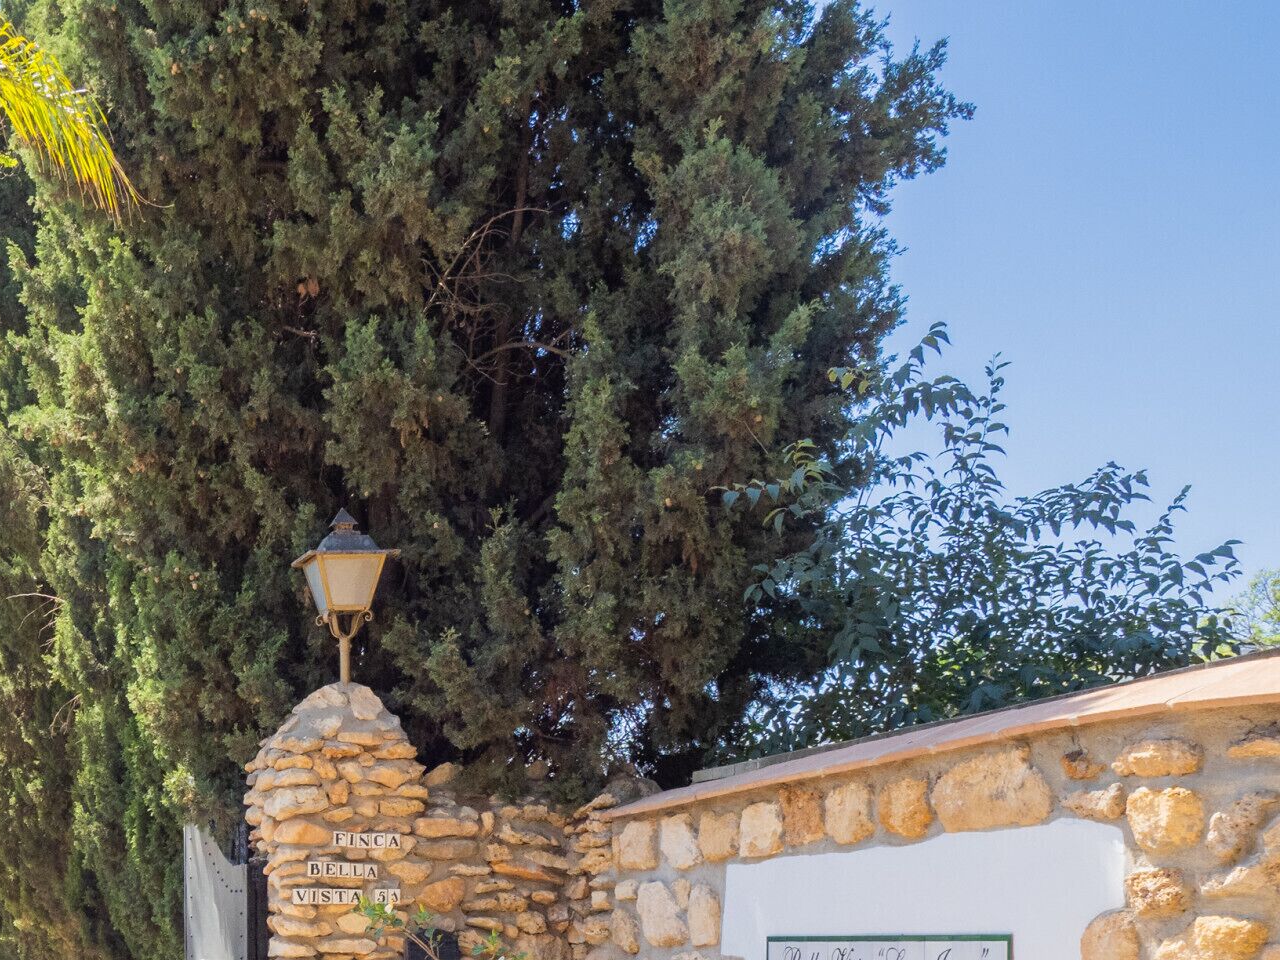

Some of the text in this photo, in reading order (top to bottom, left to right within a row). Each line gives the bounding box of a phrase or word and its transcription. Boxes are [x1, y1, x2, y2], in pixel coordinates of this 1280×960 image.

[335, 833, 398, 847] FINCA
[311, 864, 377, 878] BELLA
[296, 890, 362, 904] VISTA
